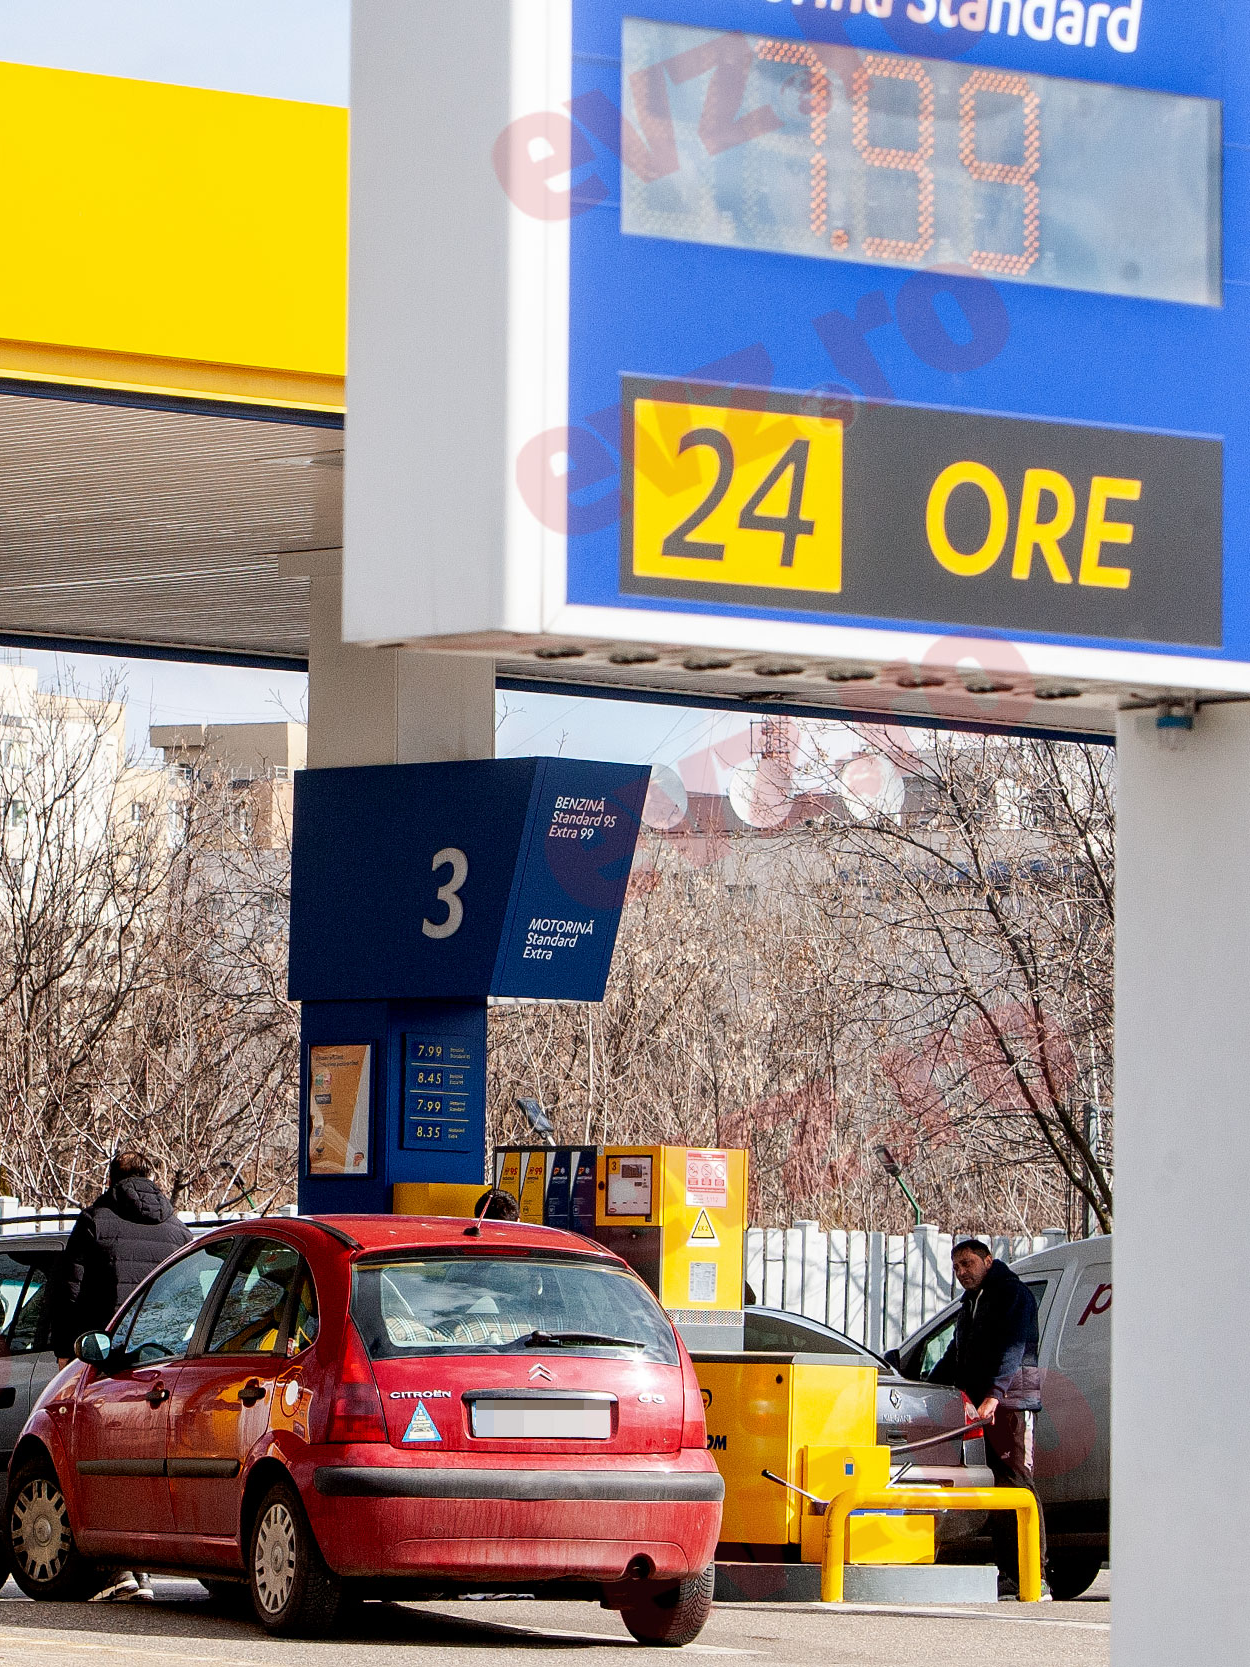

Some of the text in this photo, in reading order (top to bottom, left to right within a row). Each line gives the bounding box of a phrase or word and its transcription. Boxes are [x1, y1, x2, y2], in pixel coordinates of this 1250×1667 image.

[755, 39, 1041, 276] 7.99
[661, 427, 1143, 590] 24 ORE
[555, 796, 606, 812] BENZINĂ
[552, 810, 617, 828] Standard 95
[549, 825, 594, 840] Extra 99
[421, 847, 469, 939] 3
[528, 918, 595, 935] MOTORINĂ
[526, 932, 579, 948] Standard
[523, 946, 553, 960] Extra
[418, 1045, 443, 1057] 7.99
[417, 1072, 442, 1085] 8.45
[417, 1099, 442, 1112] 7.99
[416, 1125, 441, 1138] 8.35
[510, 1167, 518, 1175] 95
[534, 1167, 542, 1175] 99
[611, 1161, 617, 1170] 3
